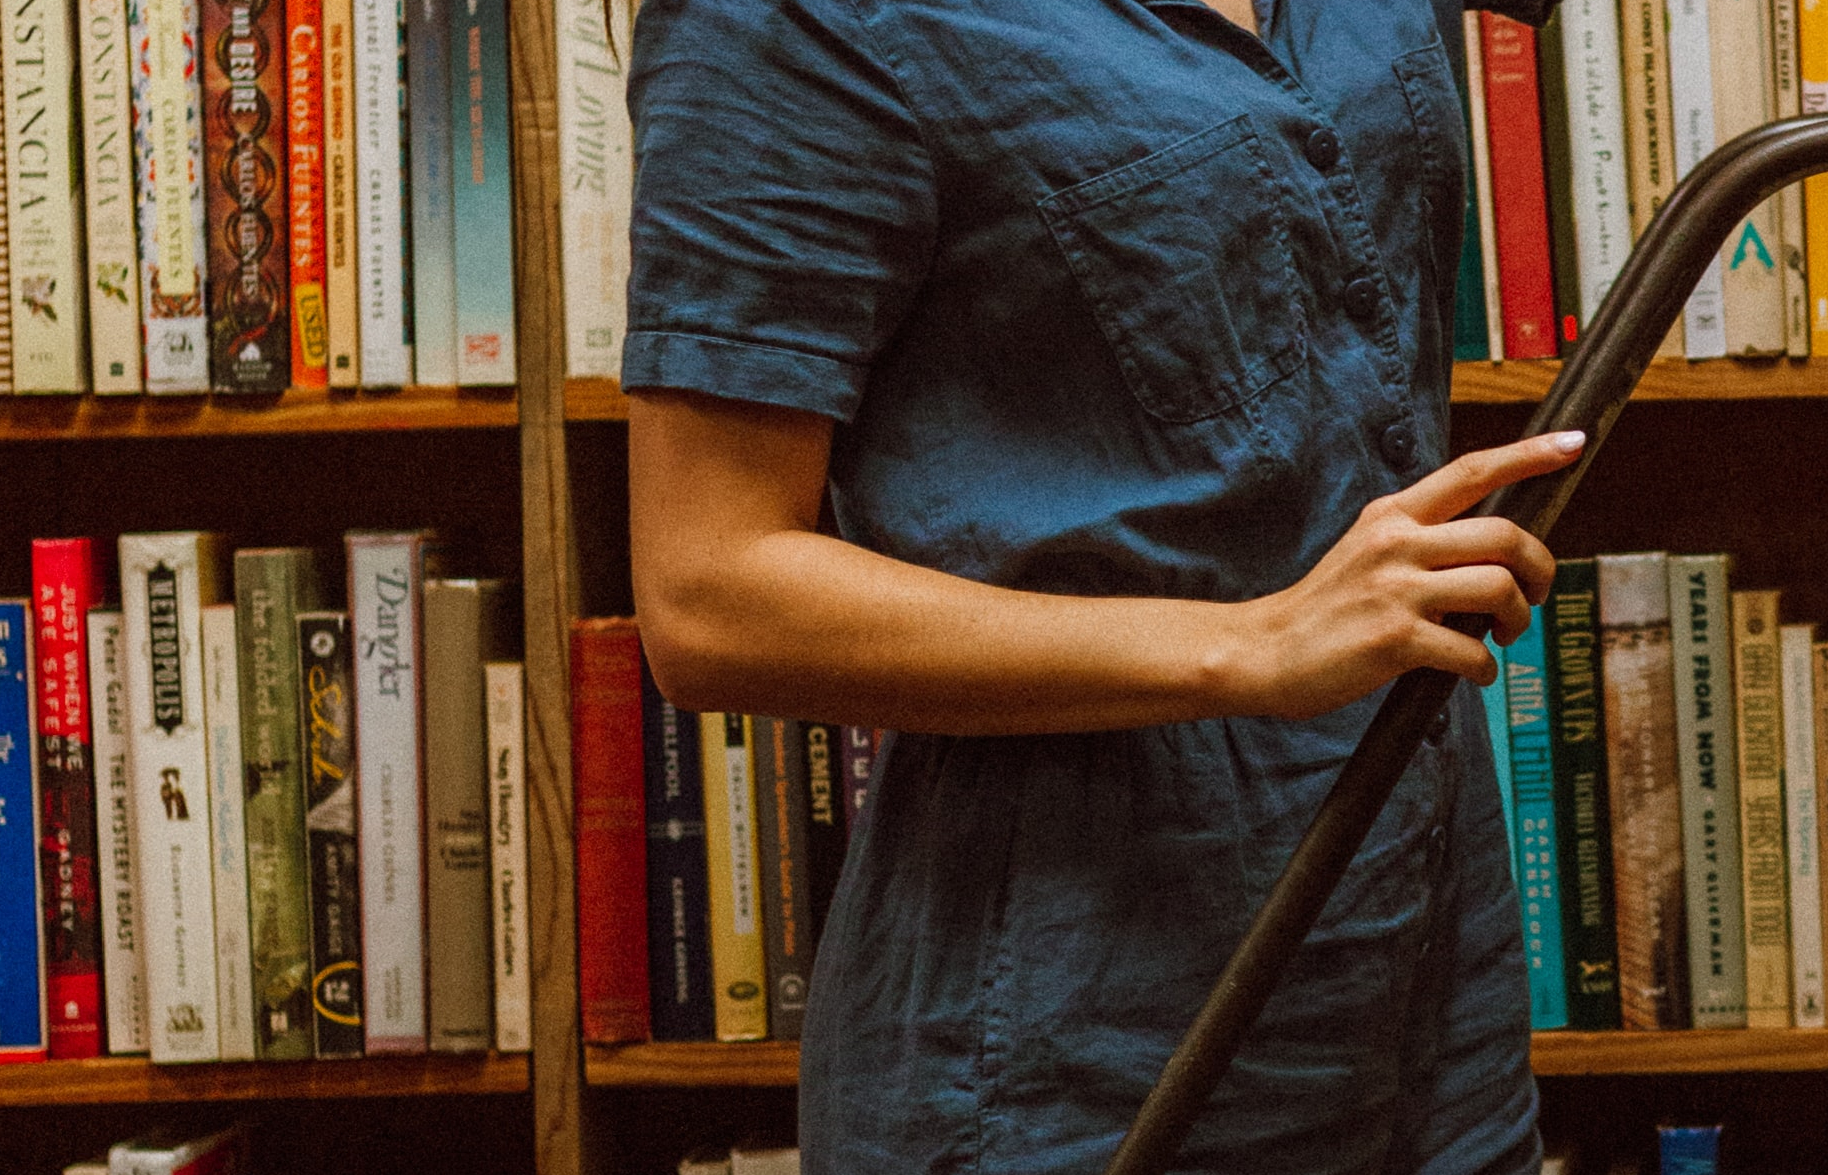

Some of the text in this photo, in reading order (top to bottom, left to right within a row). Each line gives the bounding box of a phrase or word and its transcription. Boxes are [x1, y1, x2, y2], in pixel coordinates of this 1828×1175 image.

[229, 43, 257, 113] DESIRE
[236, 134, 258, 207] CARLOS
[289, 24, 319, 267] CARLOS FUENTES
[160, 97, 184, 279] CARLOS FUENTES
[238, 213, 260, 297] FUENTES
[299, 295, 326, 360] USED
[1687, 571, 1710, 644] YEARS
[40, 583, 62, 771] ARE SAFEST
[60, 583, 84, 771] JUST WHEN WE
[103, 626, 122, 675] Peter
[148, 578, 183, 723] METROPOLIS
[1690, 654, 1714, 721] FROM
[108, 753, 127, 789] THE
[808, 726, 834, 826] CEMENT
[1695, 732, 1718, 792] NOW
[109, 795, 131, 884] MYSTERY
[1703, 809, 1718, 863] GARY
[56, 825, 75, 933] GADNEY
[115, 891, 134, 953] ROAST
